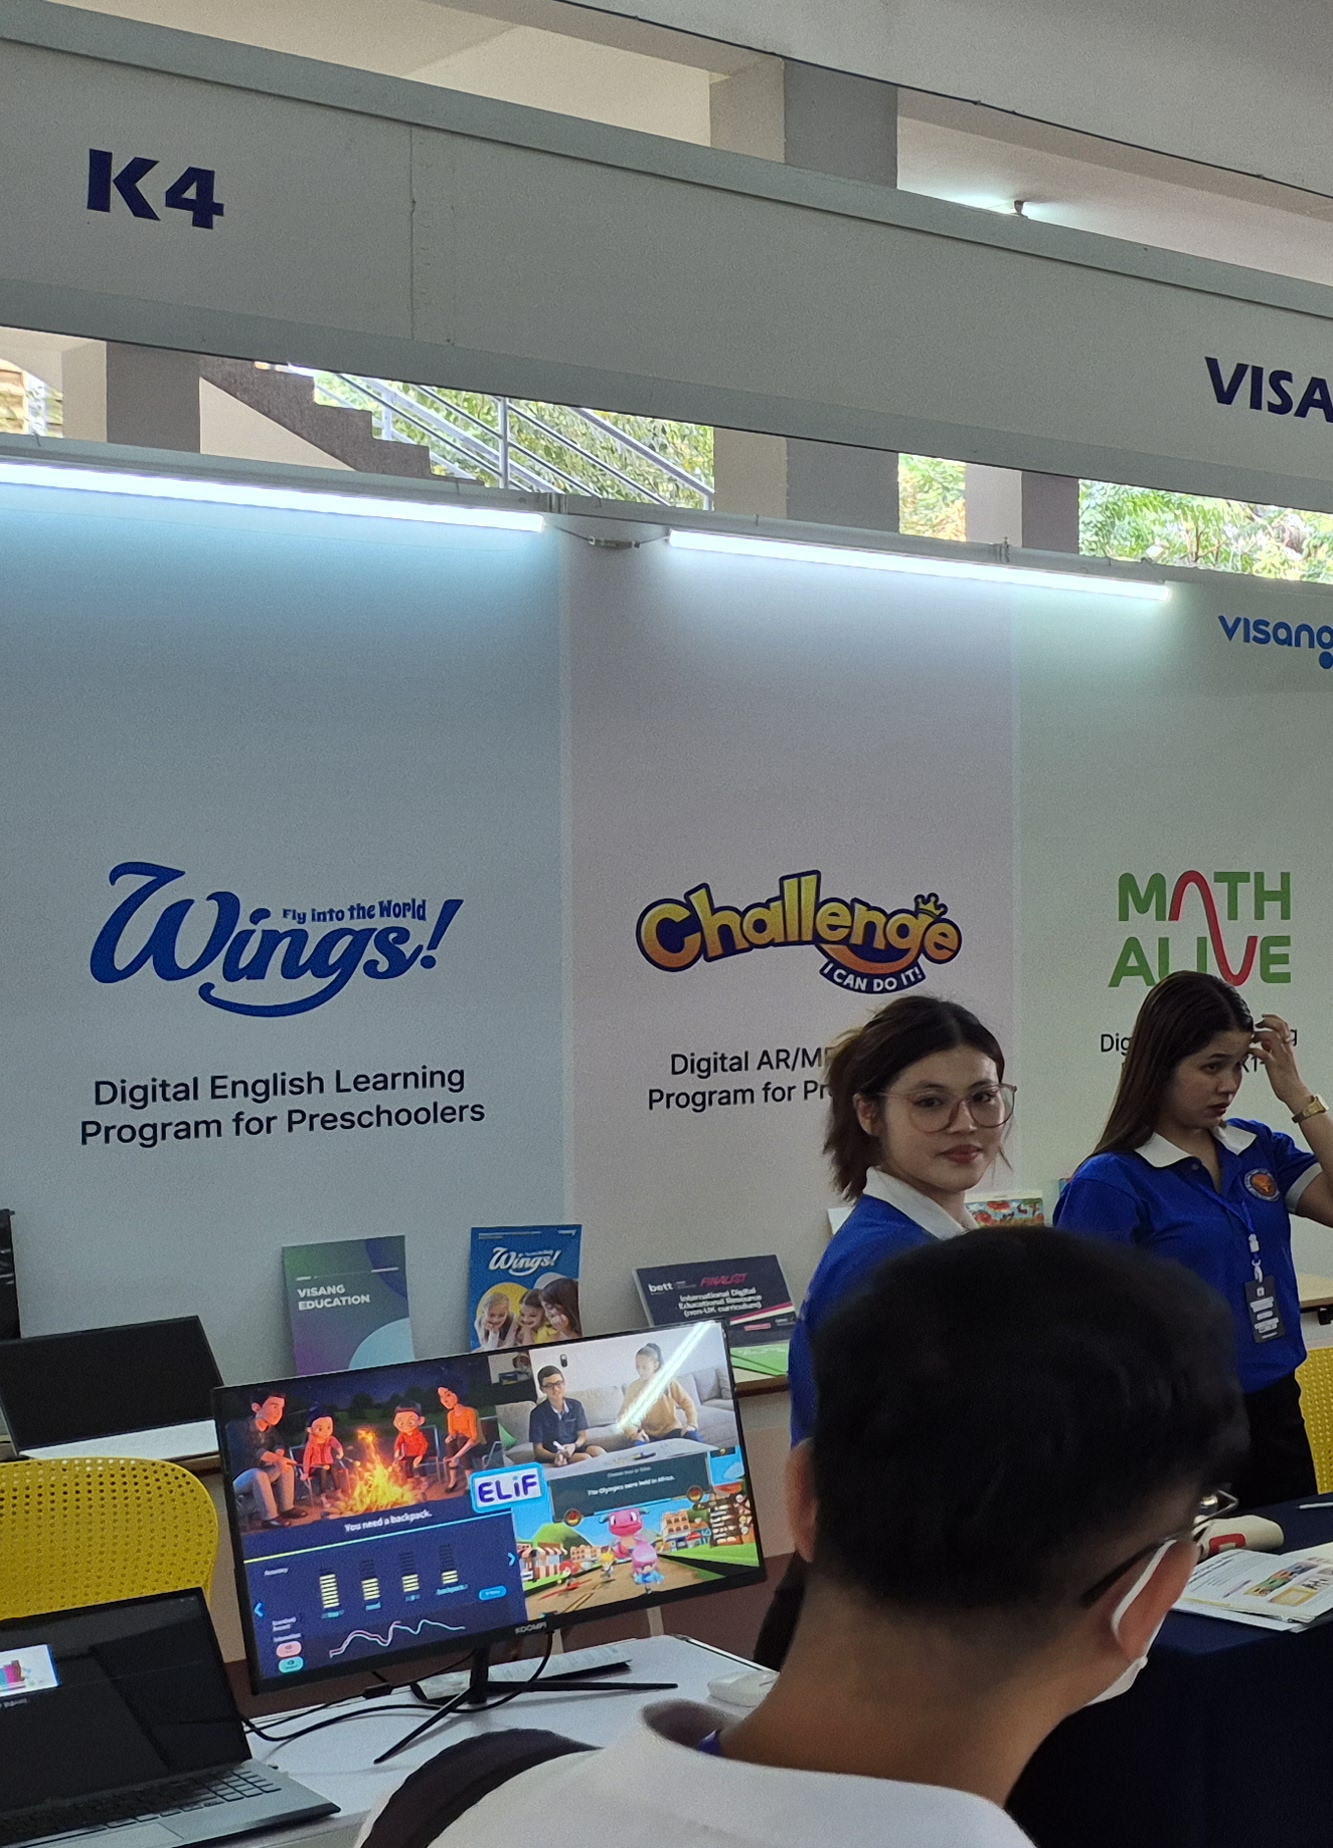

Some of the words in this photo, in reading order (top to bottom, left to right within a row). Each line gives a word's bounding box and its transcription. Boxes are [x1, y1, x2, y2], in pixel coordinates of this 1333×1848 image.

[86, 148, 225, 230] K4
[282, 908, 307, 924] Fly
[311, 907, 345, 922] into
[348, 902, 376, 920] the
[378, 898, 427, 921] World
[638, 872, 961, 970] Challenge
[89, 861, 464, 1018] Wings!
[823, 962, 832, 975] I
[833, 968, 868, 992] CAN
[872, 976, 898, 992] DO
[900, 966, 924, 985] IT!
[670, 1050, 749, 1079] Digital
[757, 1047, 825, 1073] AR/M
[94, 1076, 198, 1110] Digital
[210, 1071, 325, 1103] English
[335, 1065, 465, 1093] Learning
[648, 1086, 755, 1113] Program
[762, 1081, 797, 1103] for
[80, 1119, 222, 1149] Program
[232, 1111, 278, 1137] for
[287, 1101, 486, 1133] Preschoolers
[488, 1246, 562, 1277] Wings!
[297, 1284, 346, 1298] VISANG
[648, 1281, 673, 1293] bett
[700, 1273, 748, 1287] FINALIST
[298, 1294, 371, 1311] EDUCATION
